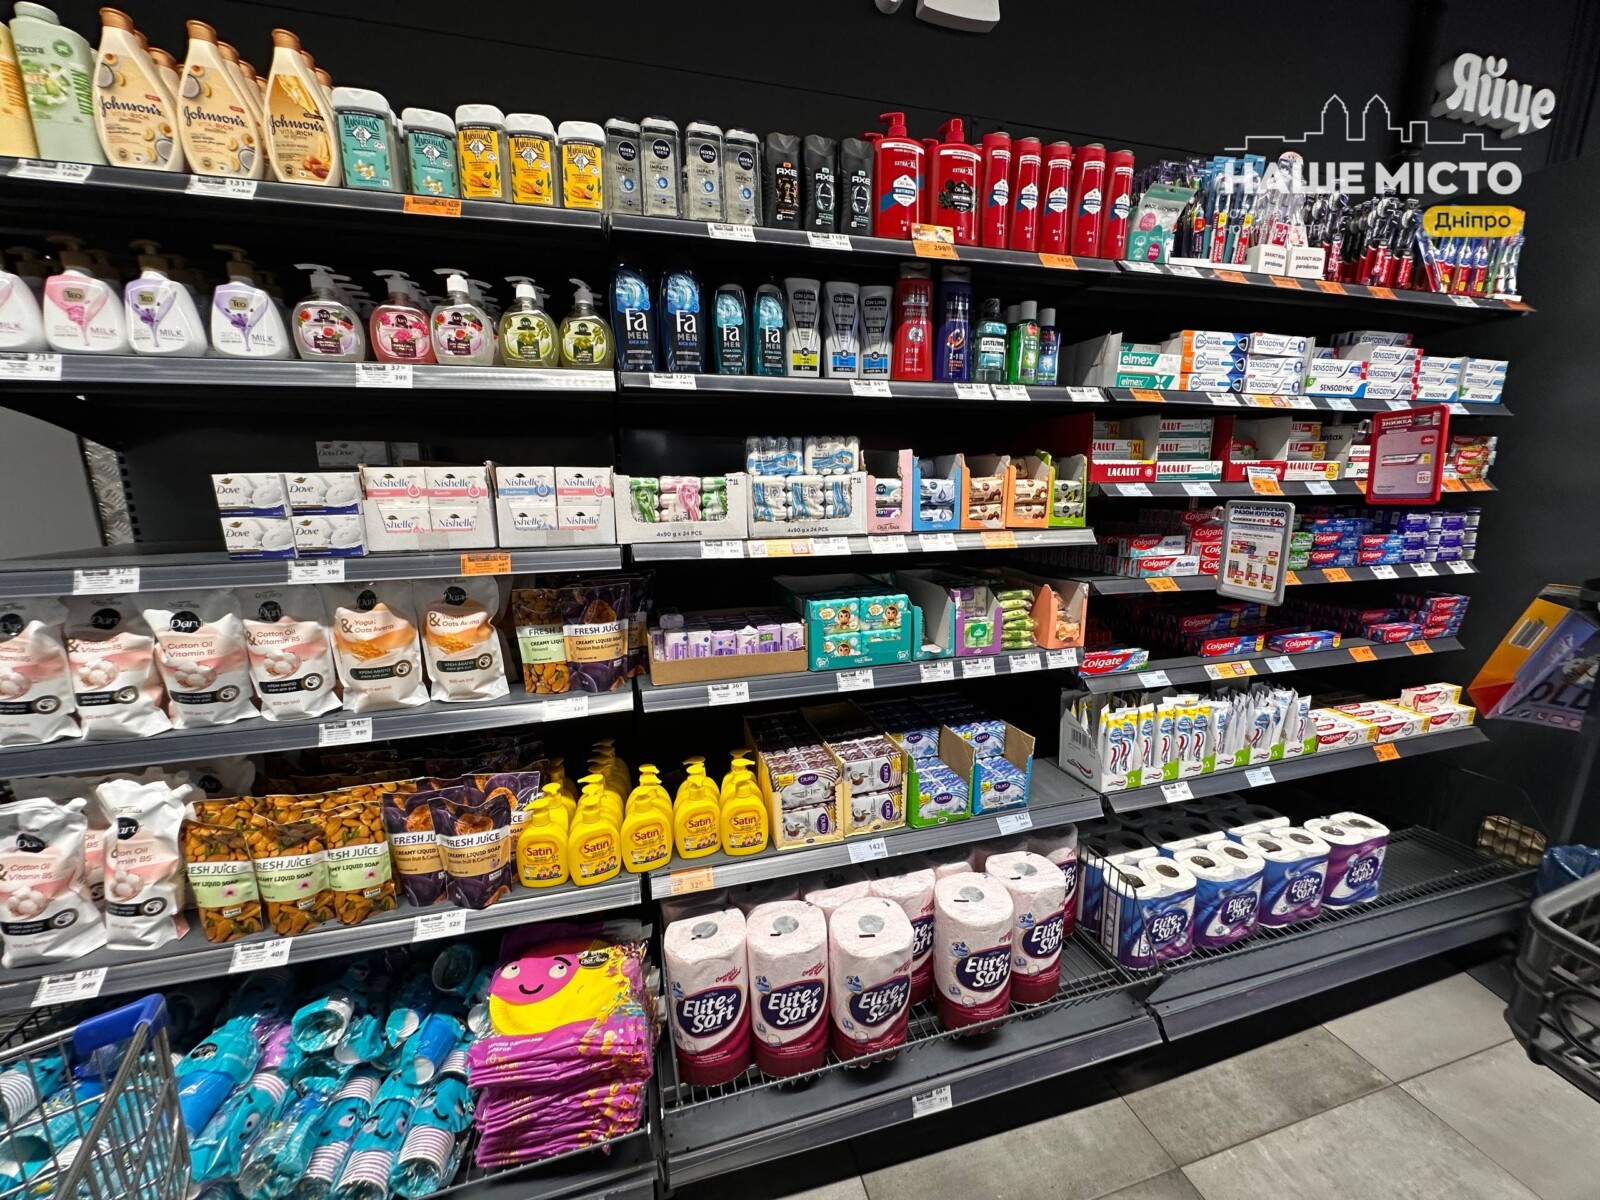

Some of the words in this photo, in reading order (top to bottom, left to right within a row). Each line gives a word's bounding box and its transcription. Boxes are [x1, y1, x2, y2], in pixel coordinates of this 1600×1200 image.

[1446, 53, 1556, 135] Яйце
[100, 96, 164, 117] Johnson's
[184, 105, 247, 127] Johnson's
[269, 114, 326, 133] Johnson's
[653, 143, 670, 154] NIVEA
[700, 148, 716, 157] NIVEA
[738, 156, 753, 164] NIVEA
[649, 163, 669, 172] IMPACT
[696, 166, 715, 175] IMPACT
[776, 167, 797, 177] AXE
[815, 172, 835, 183] AXE
[851, 175, 871, 185] AXE
[65, 290, 82, 301] TEO
[138, 293, 153, 303] TEO
[231, 299, 246, 308] TEO
[626, 308, 647, 331] Fa
[676, 310, 696, 333] Fa
[90, 327, 116, 336] MILK
[159, 329, 182, 337] MILK
[678, 333, 697, 341] MEN
[723, 324, 739, 341] Fa
[765, 325, 781, 343] Fa
[251, 334, 274, 343] MILK
[1122, 353, 1153, 365] elmex
[1121, 378, 1144, 386] elmex
[1320, 384, 1353, 392] SENSODYNE
[1109, 424, 1119, 435] XL
[1132, 443, 1142, 454] XL
[1108, 467, 1140, 477] LACALUT
[1157, 464, 1191, 473] LACALUT
[372, 478, 410, 488] Nishelle
[432, 479, 472, 489] Nishelle
[504, 477, 540, 488] Nishelle
[562, 477, 598, 488] Nishelle
[217, 485, 240, 494] Dove
[290, 484, 313, 493] Dove
[385, 519, 415, 530] ishelle
[226, 529, 250, 537] Dove
[295, 527, 319, 536] Dove
[1143, 560, 1171, 568] Colgate
[429, 612, 440, 626] &
[529, 626, 557, 636] FRESH
[574, 626, 600, 635] FRESH
[602, 623, 621, 632] JUiCE
[1389, 630, 1408, 638] Colgate
[246, 632, 258, 646] &
[256, 630, 281, 638] Cotton
[1285, 638, 1314, 647] Colgate
[1206, 641, 1235, 650] Colgate
[1082, 657, 1122, 668] Colgate
[688, 818, 712, 828] Satin
[733, 815, 756, 825] Satin
[394, 834, 421, 845] FRESH
[635, 828, 659, 840] Satin
[446, 837, 475, 848] FRESH
[476, 832, 500, 843] JUiCE
[352, 846, 379, 857] JUiCE
[466, 849, 485, 857] LIQUID
[485, 845, 501, 853] SOAP
[527, 846, 553, 856] Satin
[583, 840, 610, 853] Satin
[297, 871, 313, 879] SOAP
[1152, 914, 1178, 933] Elite
[1155, 924, 1182, 941] Soft
[965, 954, 1005, 973] Elite
[975, 965, 1008, 984] Soft
[768, 993, 810, 1012] Elite
[858, 990, 900, 1009] Elite
[682, 999, 725, 1017] Elite
[865, 1000, 906, 1022] Soft
[776, 1003, 818, 1025] Soft
[693, 1010, 734, 1033] Soft
